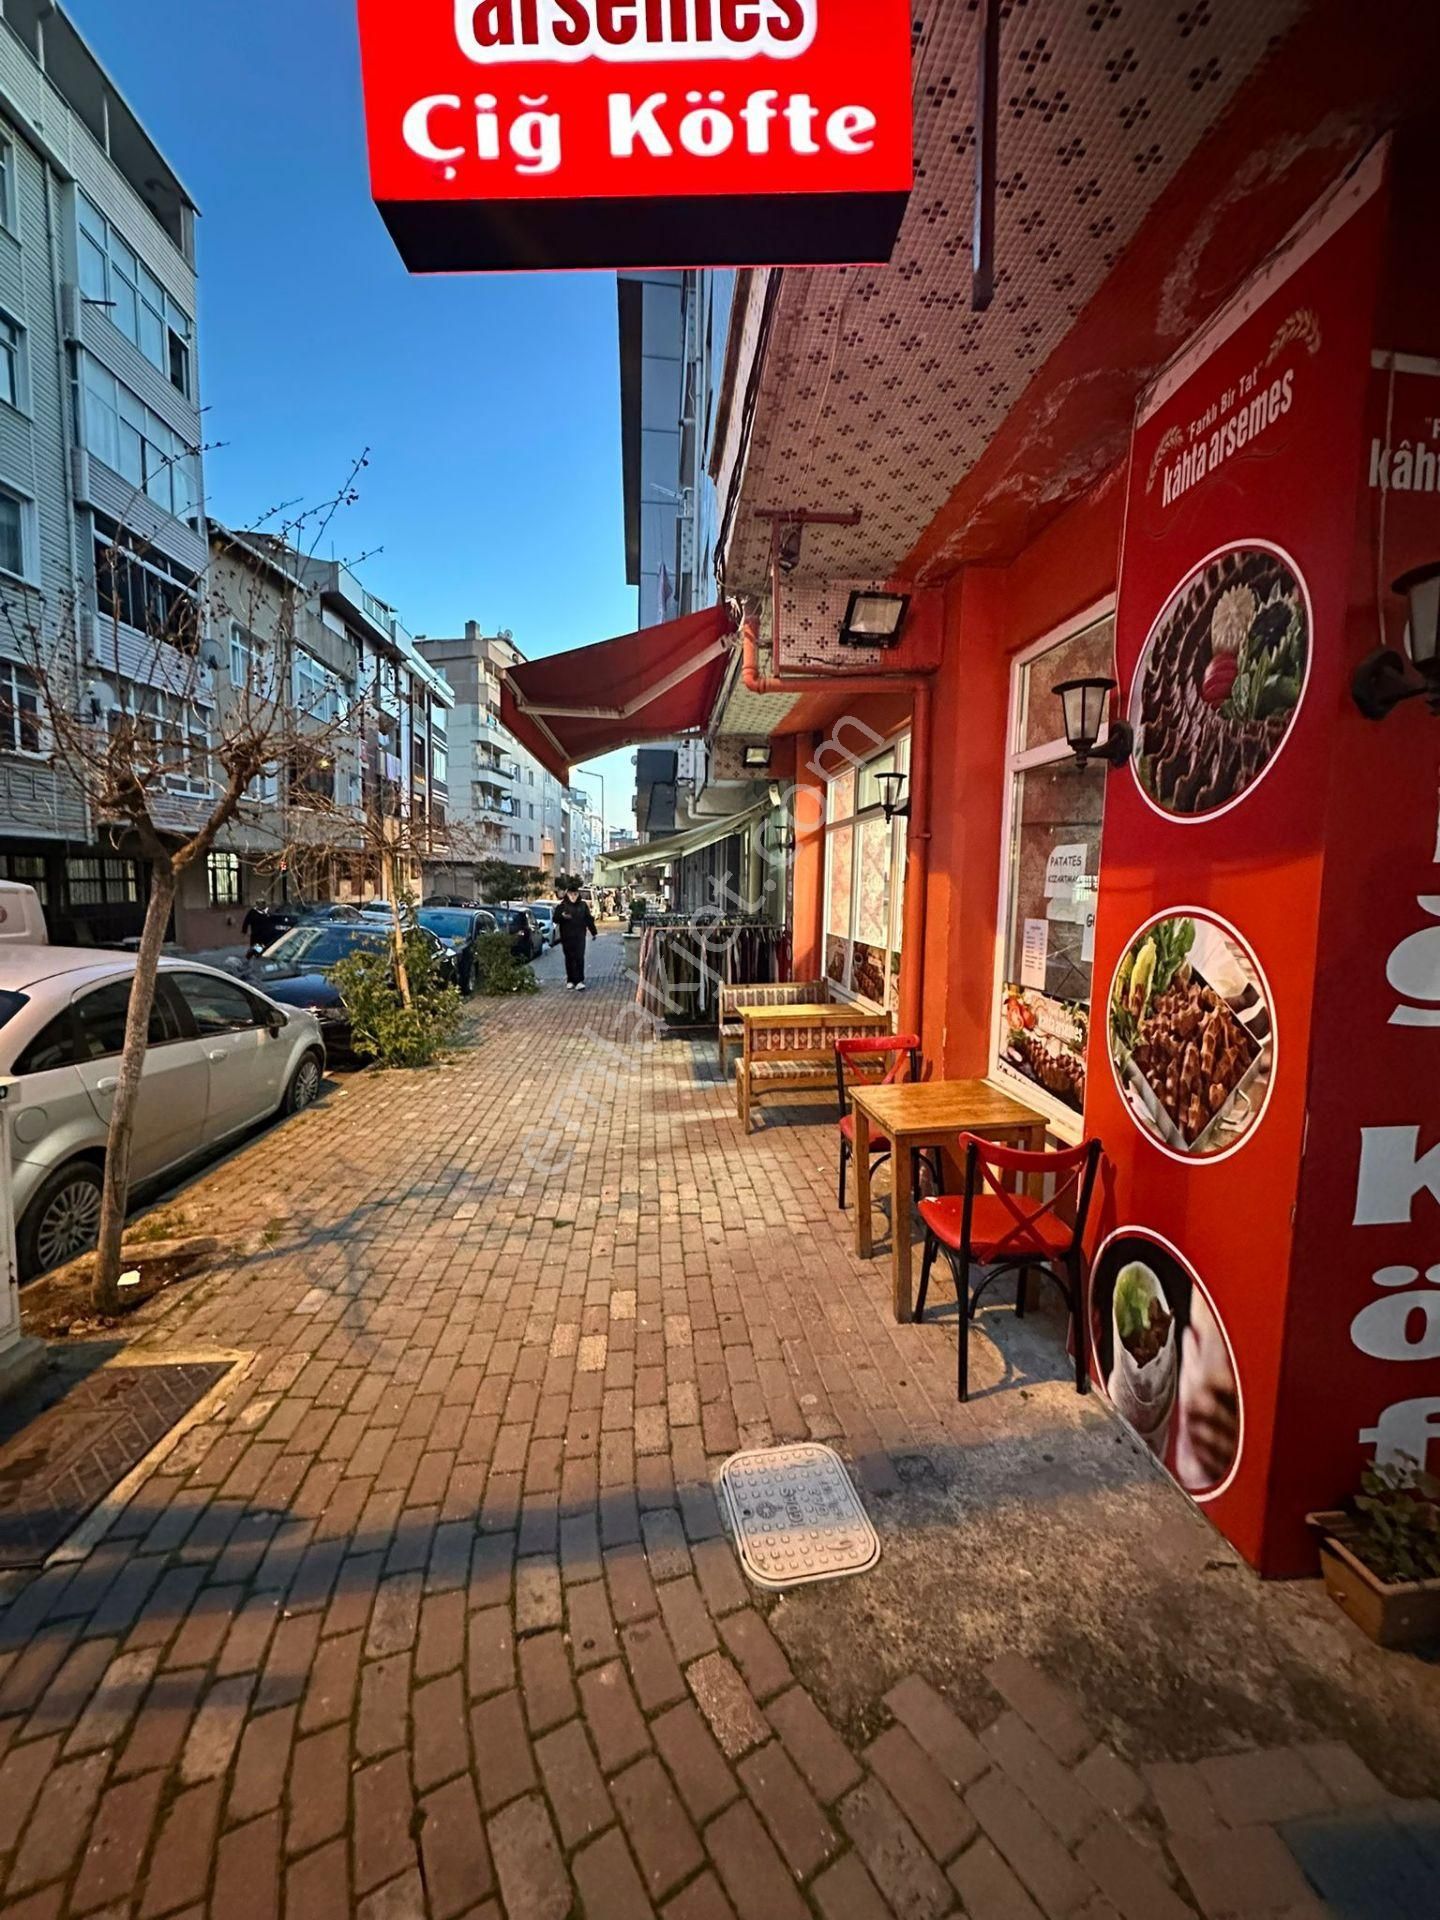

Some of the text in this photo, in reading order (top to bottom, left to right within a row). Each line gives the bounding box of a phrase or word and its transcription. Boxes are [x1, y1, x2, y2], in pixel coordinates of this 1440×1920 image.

[401, 88, 877, 181] Çiğ Köfte
[1221, 387, 1236, 415] Bir
[1161, 368, 1295, 508] kâhta arsemes
[1368, 438, 1440, 492] kâh
[1049, 855, 1082, 867] PATATES
